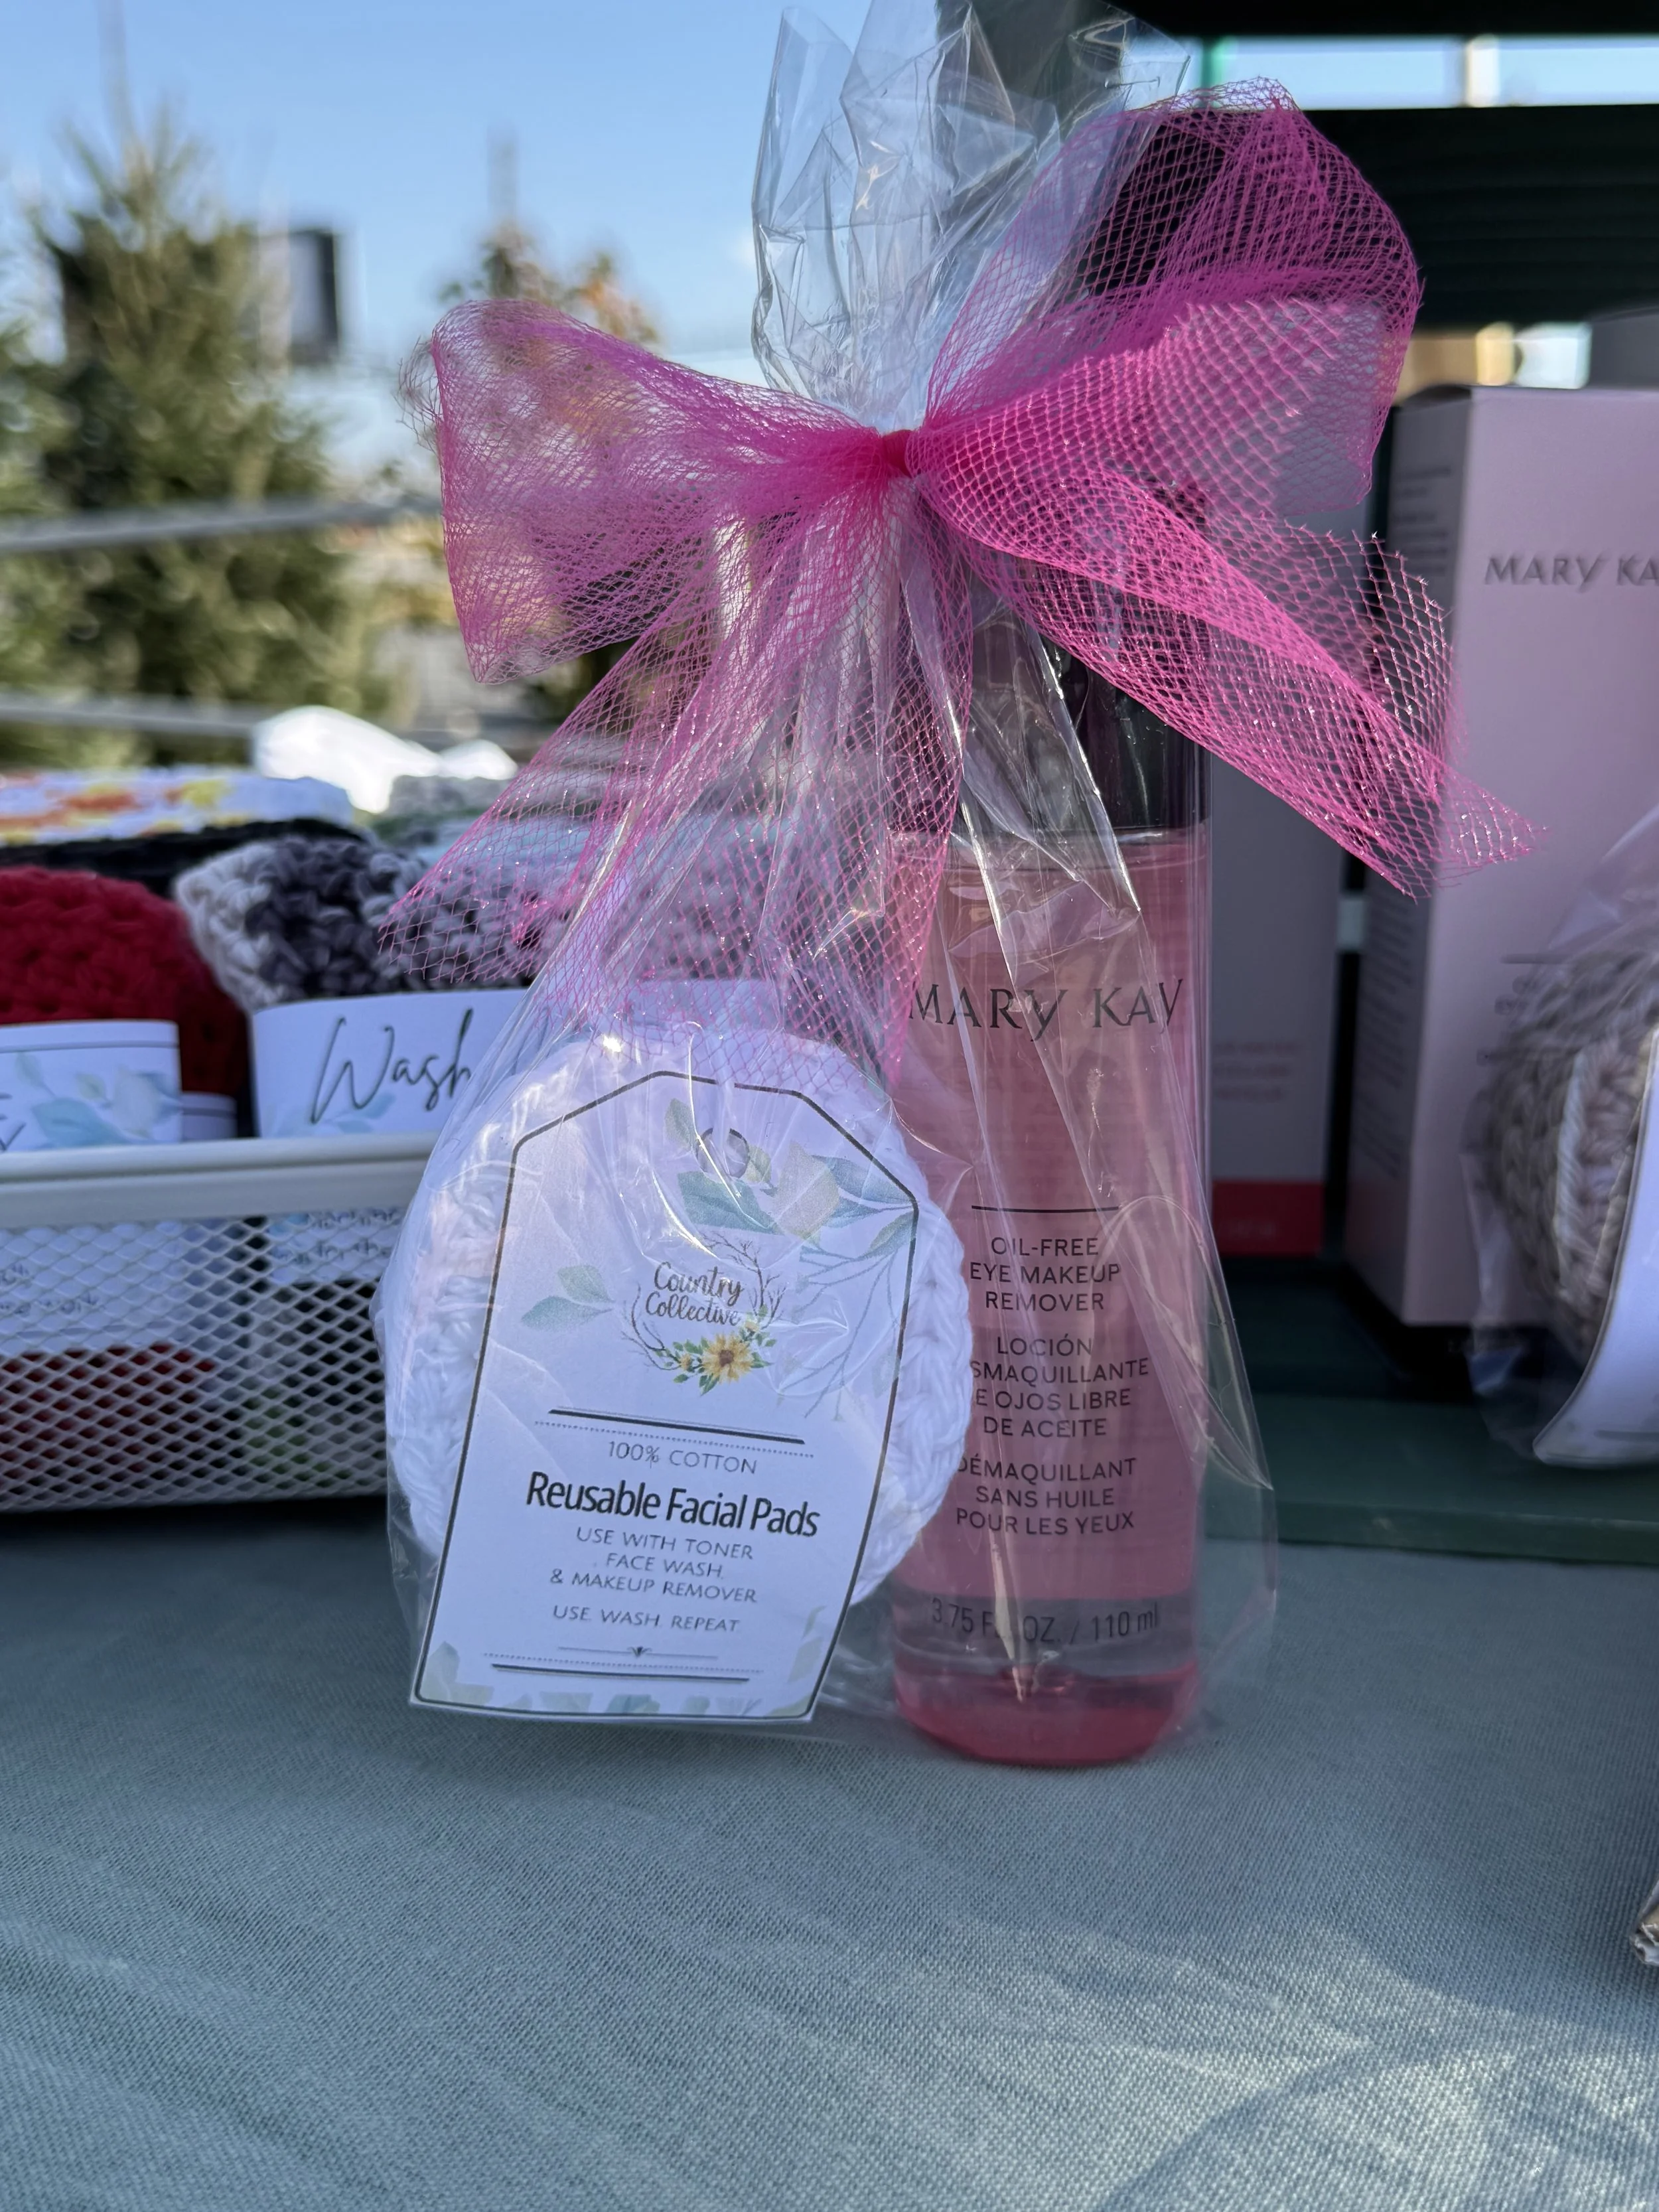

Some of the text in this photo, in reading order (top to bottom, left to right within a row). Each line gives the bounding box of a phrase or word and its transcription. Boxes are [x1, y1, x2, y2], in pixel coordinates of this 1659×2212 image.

[1484, 552, 1659, 595] MARY KA
[908, 984, 1068, 1042] MARY
[309, 1007, 474, 1125] Wash
[991, 1236, 1100, 1257] OIL-FREE
[654, 1261, 745, 1307] Country
[970, 1262, 1121, 1284] EYE MAKEUP
[645, 1290, 742, 1327] Collective
[985, 1291, 1105, 1312] REMOVER
[997, 1333, 1094, 1357] LOCIÓN
[969, 1357, 1149, 1388] SMAQUILLANTE
[975, 1388, 1131, 1411] E OJOS LIBRE
[983, 1416, 1108, 1438] DE ACEITE
[609, 1440, 758, 1475] 100% COTTON
[526, 1471, 821, 1537] Reusable Facial Pads
[975, 1485, 1114, 1509] SANS HUILE
[956, 1507, 1135, 1535] POUR LES YEUX
[576, 1526, 754, 1560] USE WITH TONER
[605, 1552, 656, 1572] FACE
[549, 1568, 758, 1603] & MAKEUP REMOVER
[932, 1597, 974, 1634] 3.75
[1092, 1611, 1130, 1641] 110
[1137, 1601, 1158, 1633] ml
